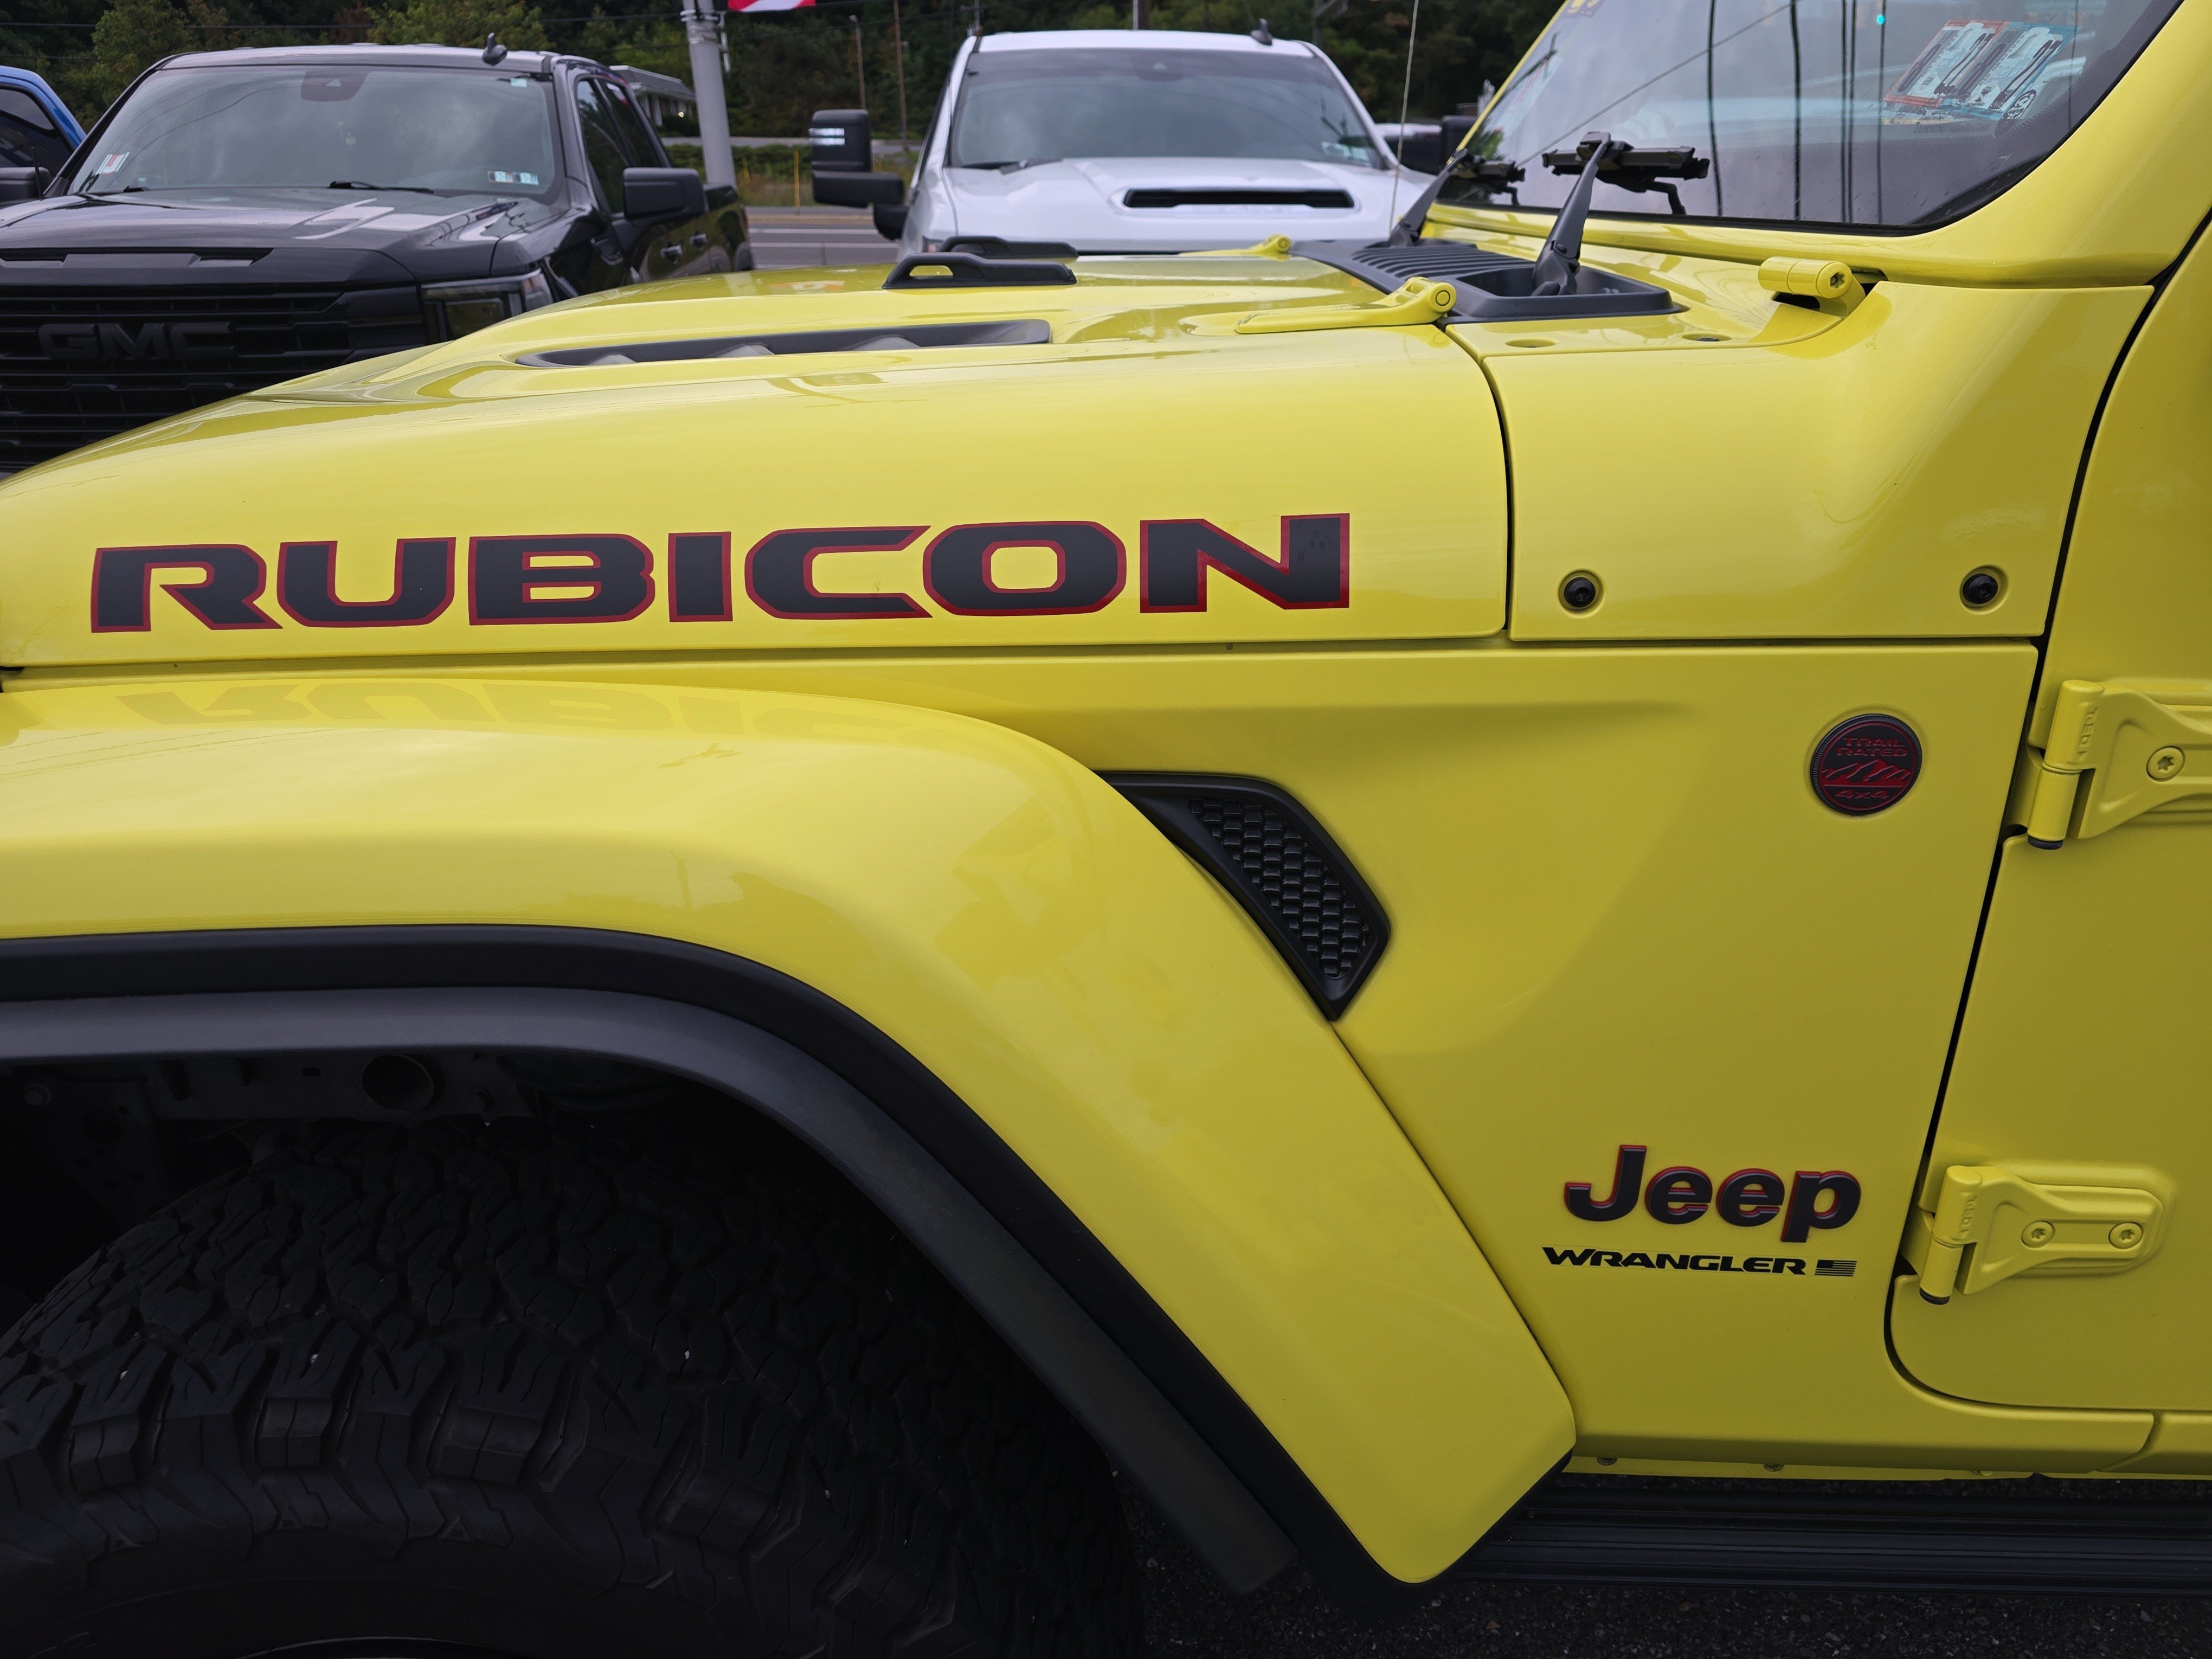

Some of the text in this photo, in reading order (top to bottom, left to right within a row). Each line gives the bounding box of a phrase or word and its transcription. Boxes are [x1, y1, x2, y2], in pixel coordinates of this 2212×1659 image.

[38, 321, 236, 360] GMC
[91, 512, 1351, 632] RUBICON
[1836, 748, 1907, 757] RATED
[1843, 737, 1905, 747] TRAIL
[1564, 1144, 1862, 1243] Jeep
[1542, 1247, 1806, 1275] WRANGLER
